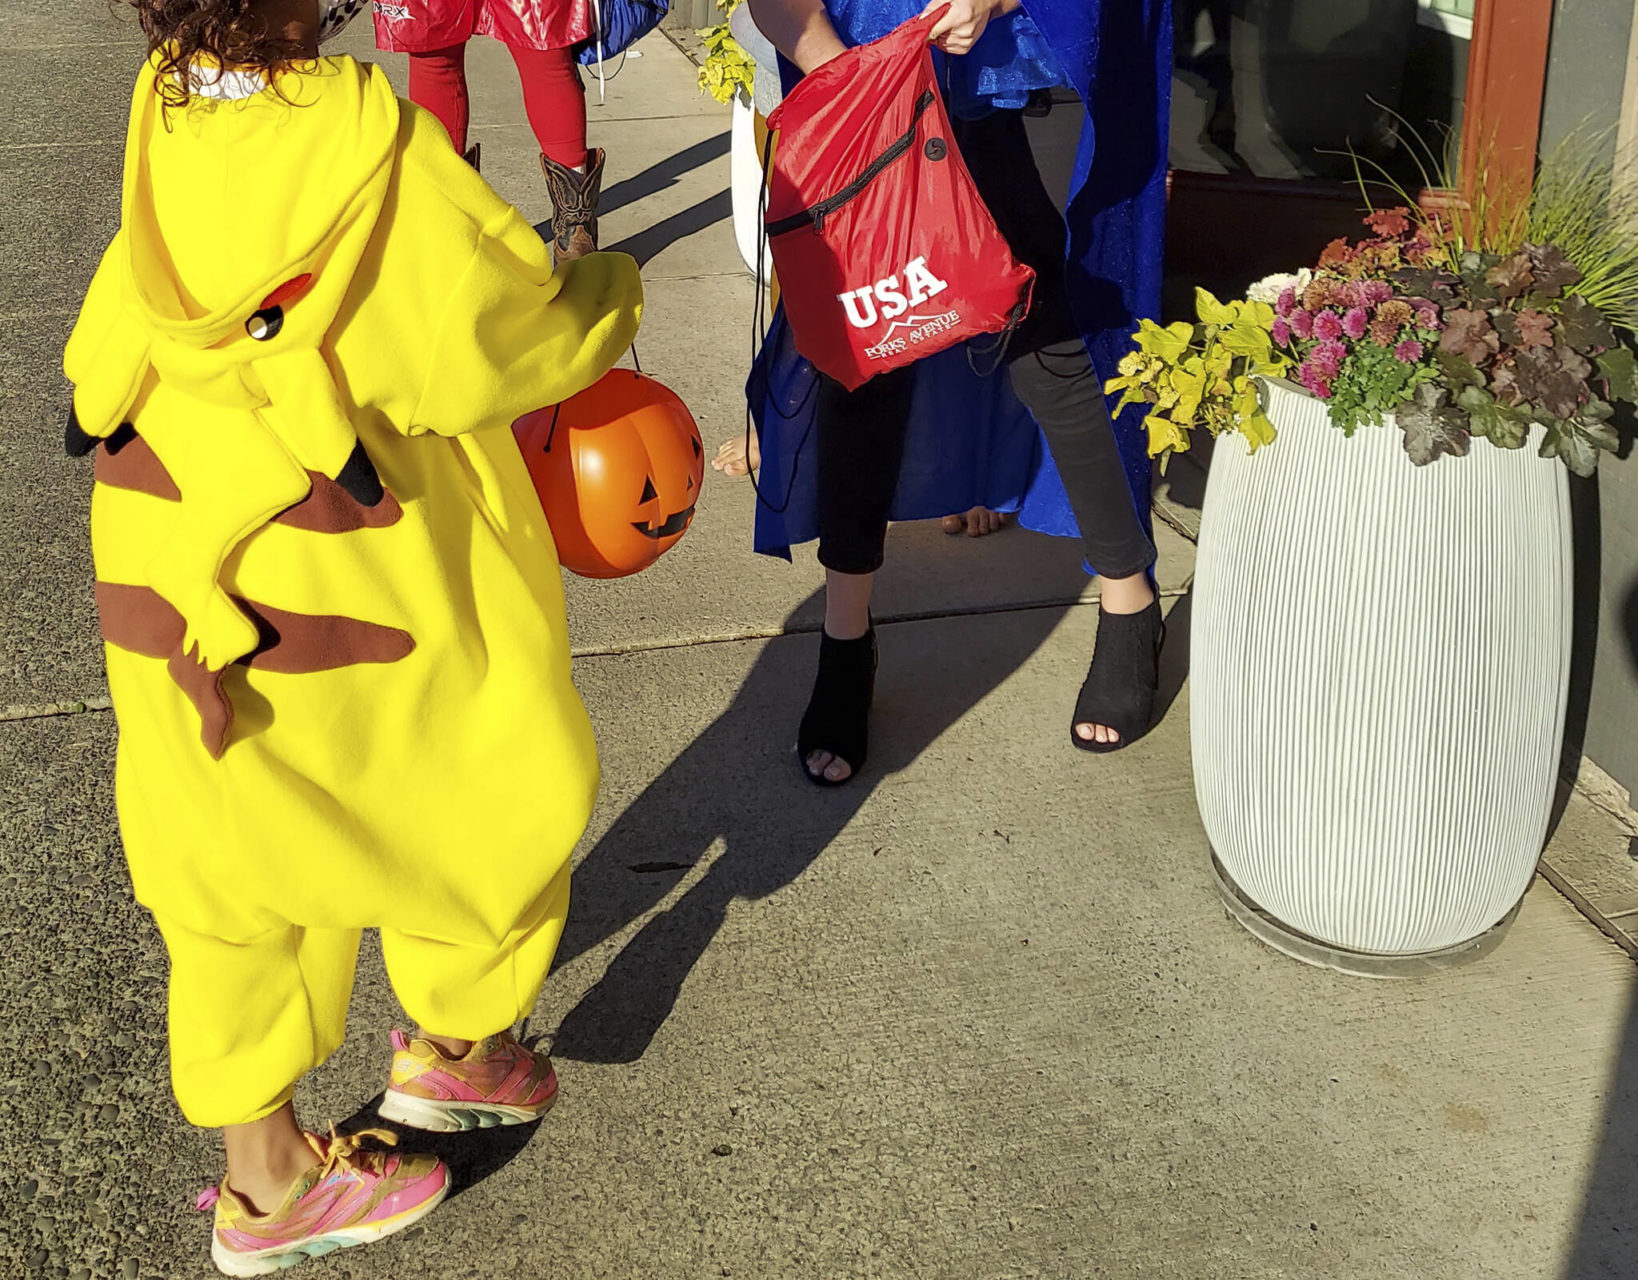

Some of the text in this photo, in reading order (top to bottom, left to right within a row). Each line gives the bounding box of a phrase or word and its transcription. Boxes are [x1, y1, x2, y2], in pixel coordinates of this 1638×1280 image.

[374, 1, 406, 18] MRX
[837, 256, 948, 328] USA
[864, 309, 960, 357] FORKS AVENUE
